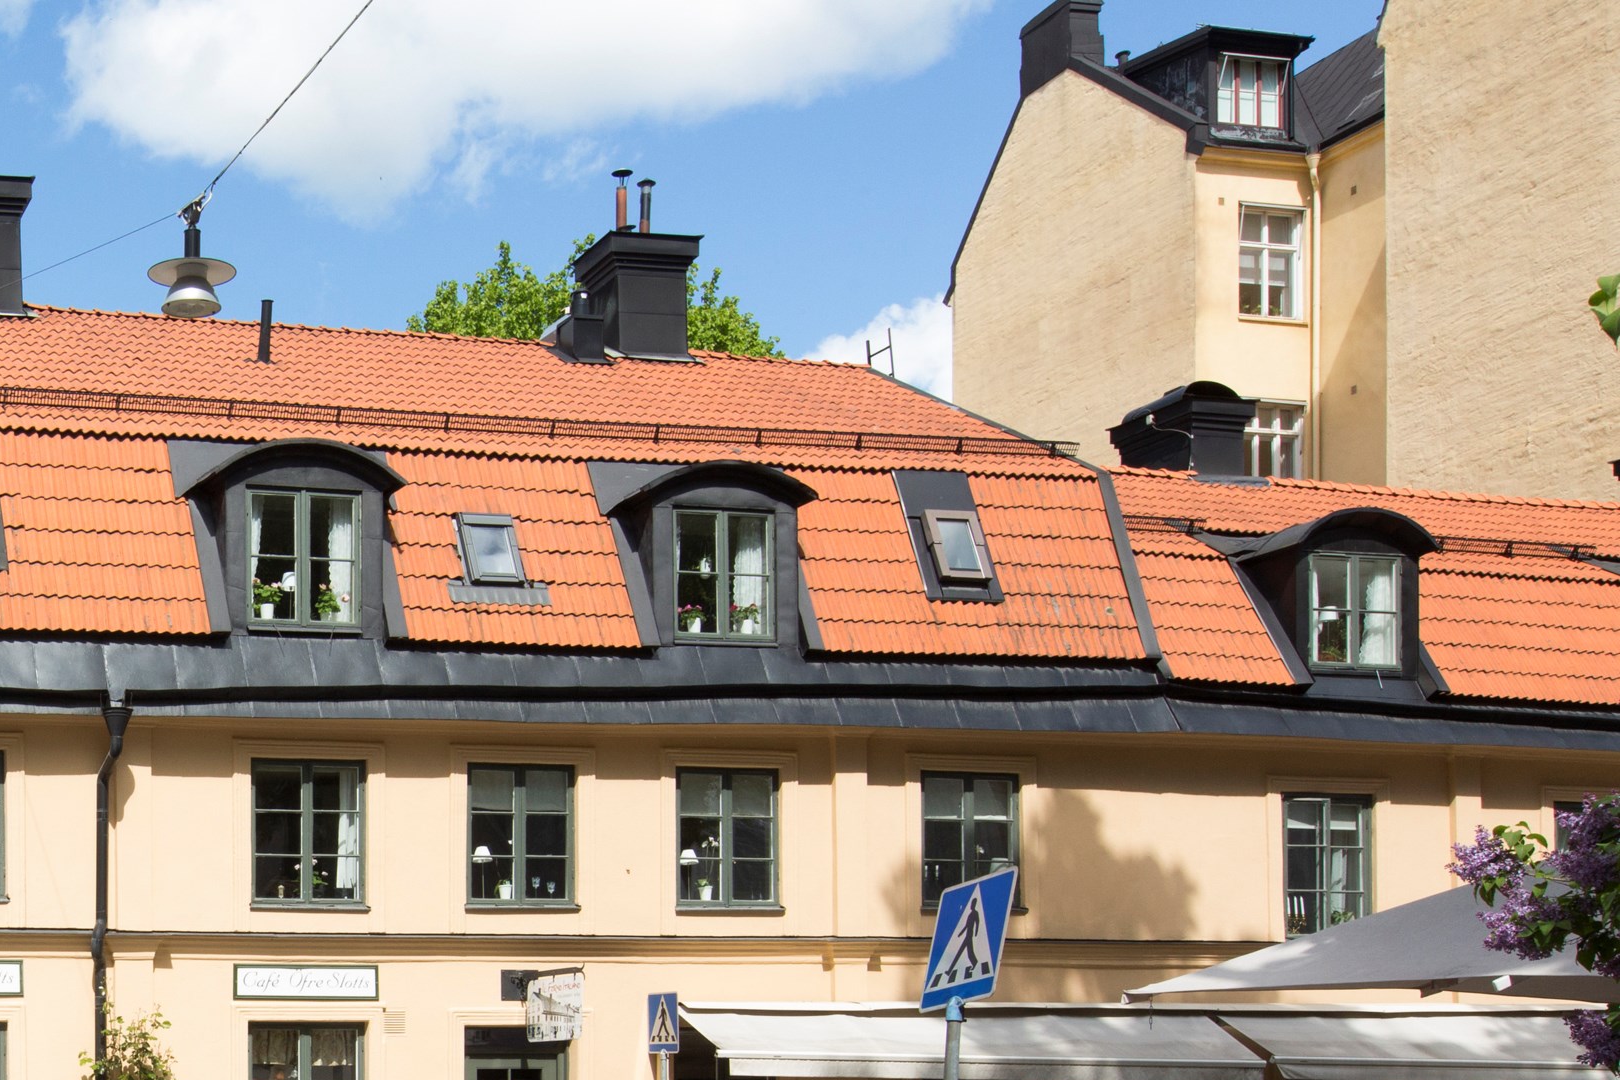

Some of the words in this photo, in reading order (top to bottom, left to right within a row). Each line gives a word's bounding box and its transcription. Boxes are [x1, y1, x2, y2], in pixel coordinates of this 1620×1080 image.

[243, 971, 281, 993] Café
[289, 968, 324, 993] Öfre
[326, 972, 369, 989] Slotts
